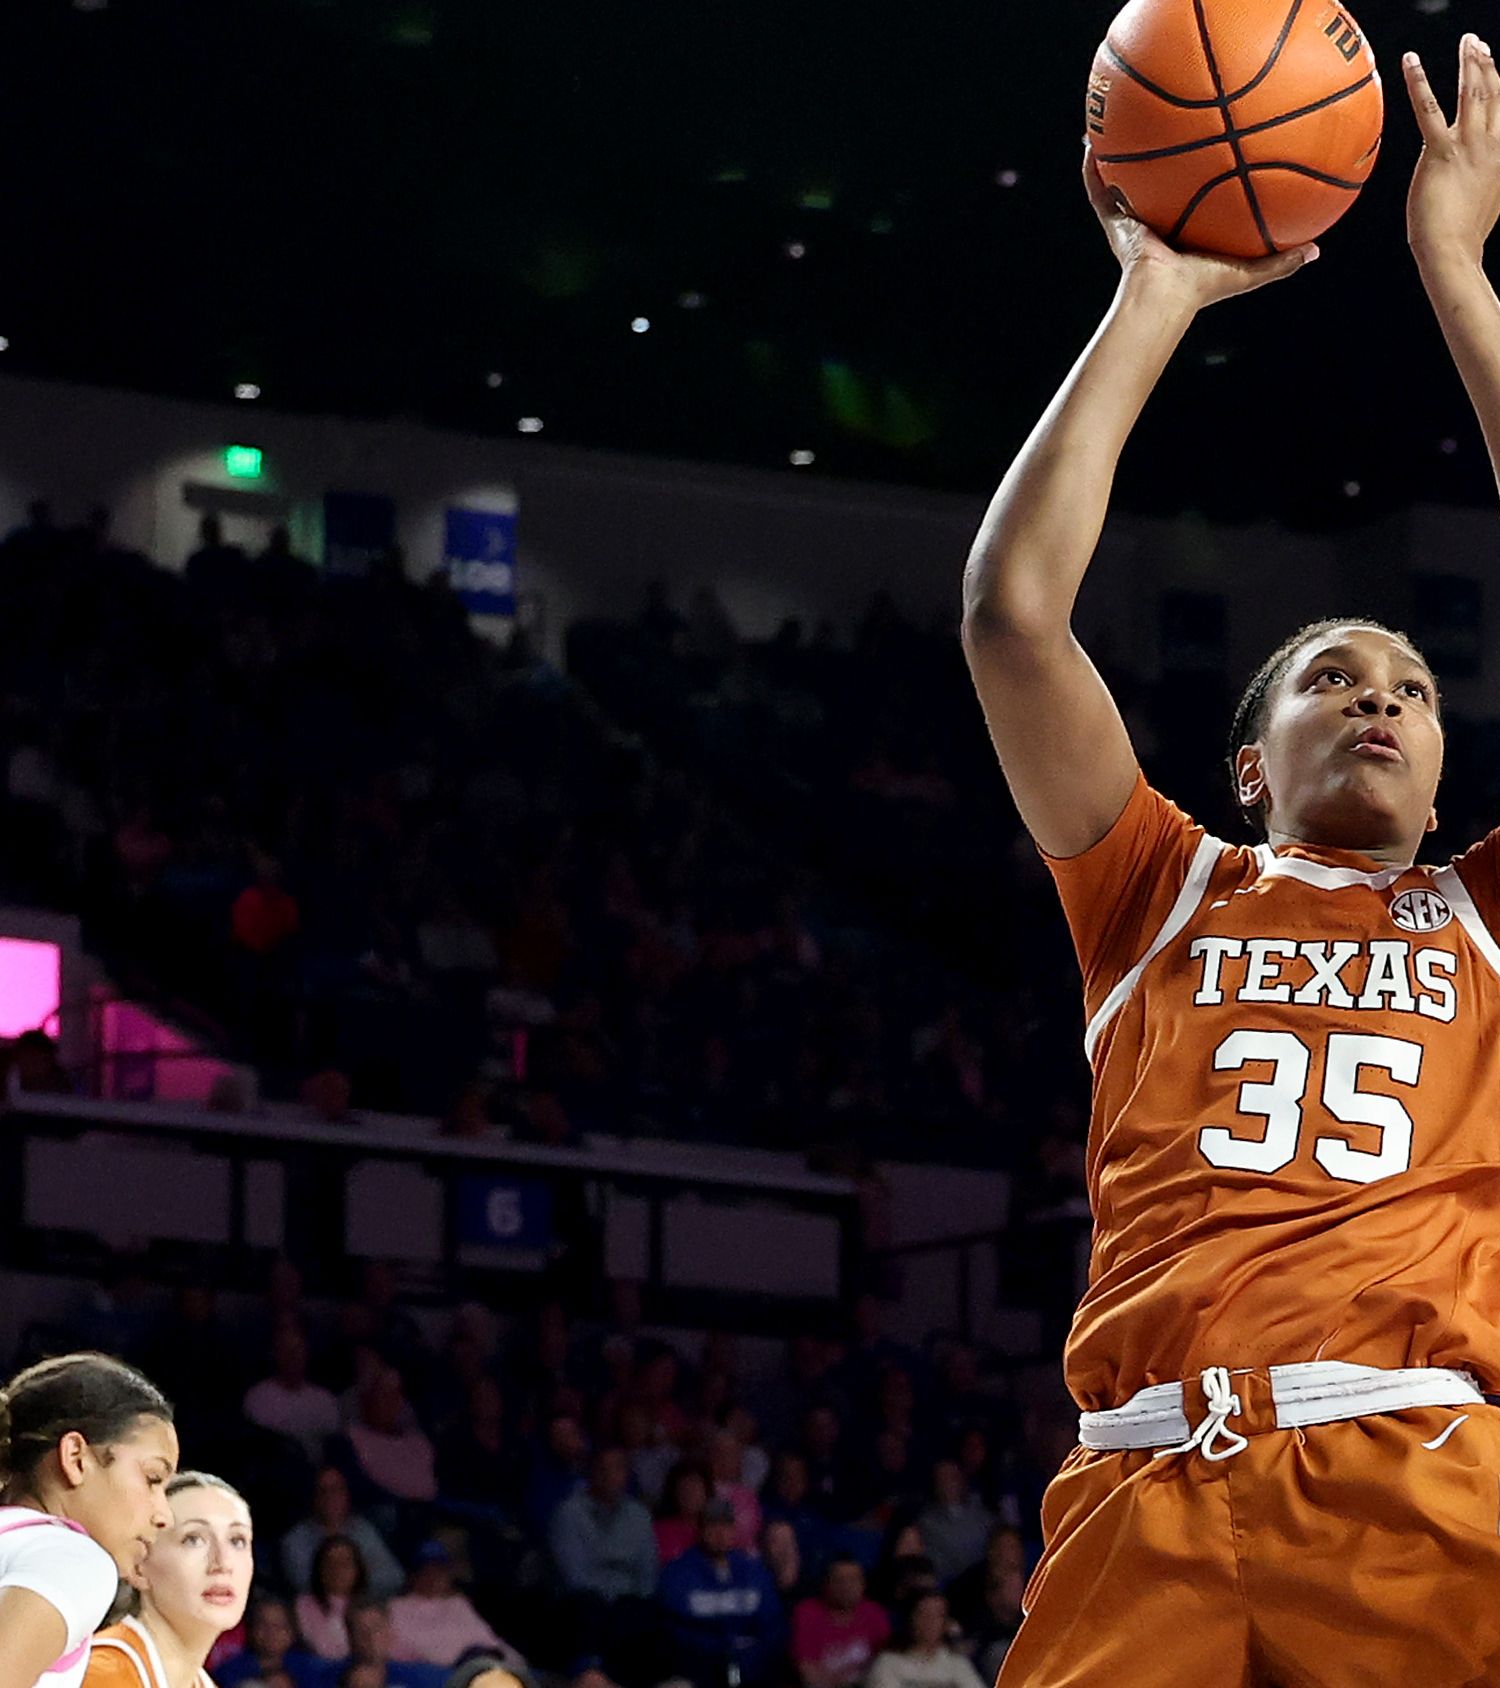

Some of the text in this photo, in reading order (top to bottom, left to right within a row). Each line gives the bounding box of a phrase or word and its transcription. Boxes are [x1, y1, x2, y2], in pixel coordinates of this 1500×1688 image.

[1391, 891, 1451, 930] SEC
[1189, 936, 1456, 1024] TEXAS
[1199, 1028, 1424, 1184] 35
